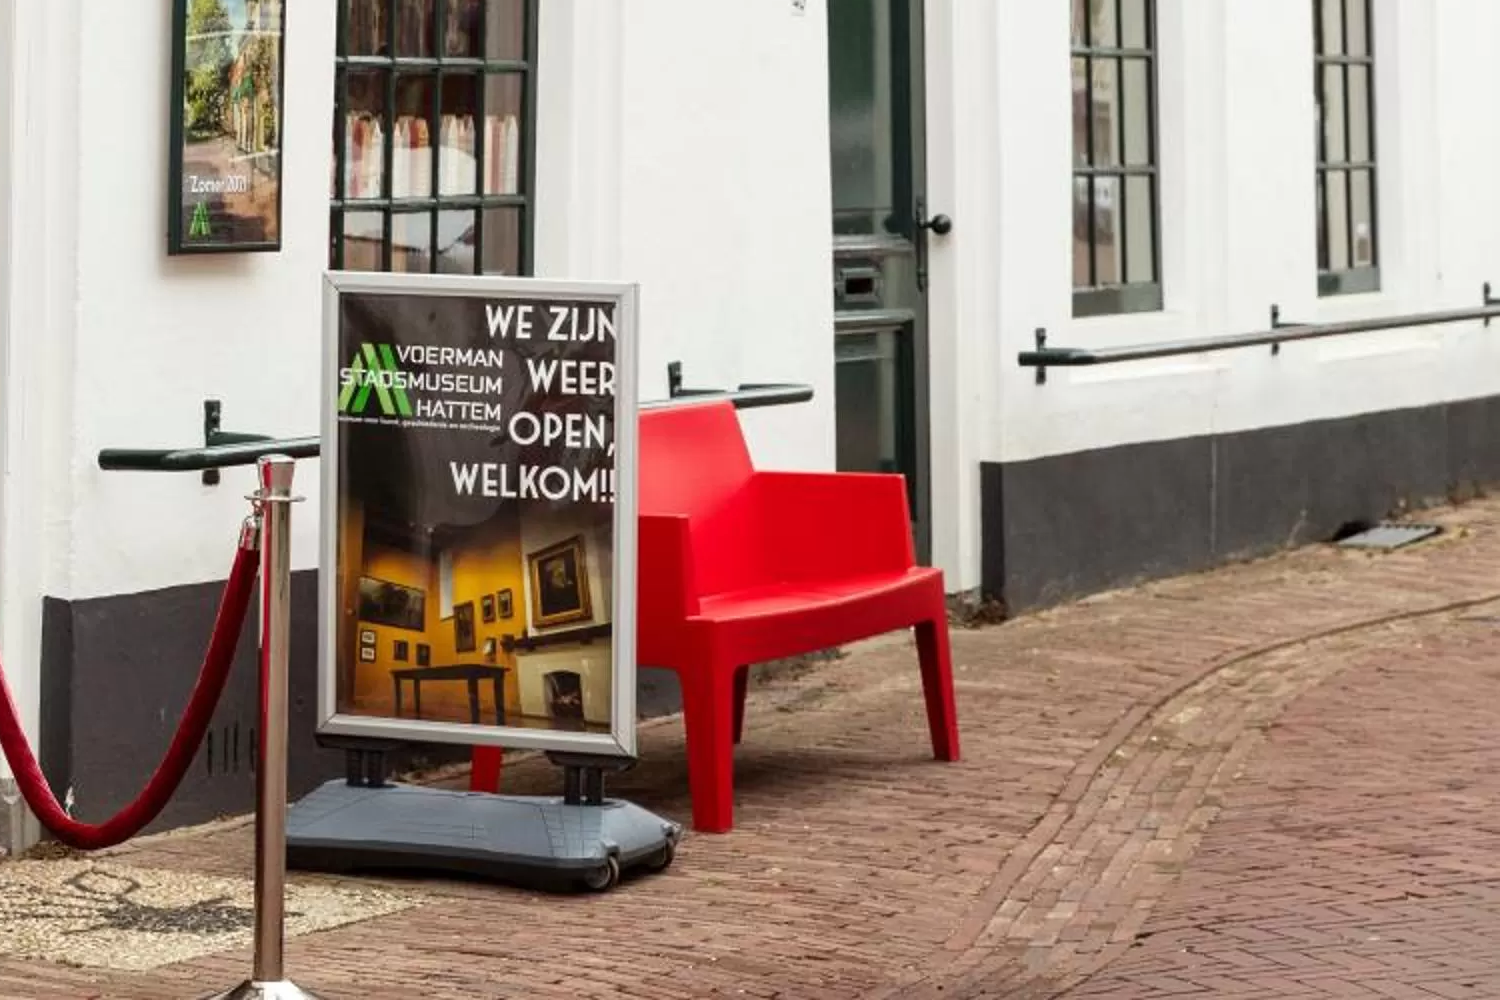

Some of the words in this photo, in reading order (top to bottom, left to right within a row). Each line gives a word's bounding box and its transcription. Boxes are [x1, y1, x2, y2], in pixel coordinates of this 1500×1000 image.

[485, 305, 533, 339] WE
[547, 306, 617, 342] ZIJN
[395, 344, 504, 368] VOERMAN
[339, 367, 503, 395] STADSMUSEUM
[527, 359, 616, 396] WEER
[416, 399, 501, 421] HATTEM
[508, 411, 616, 457] OPEN,
